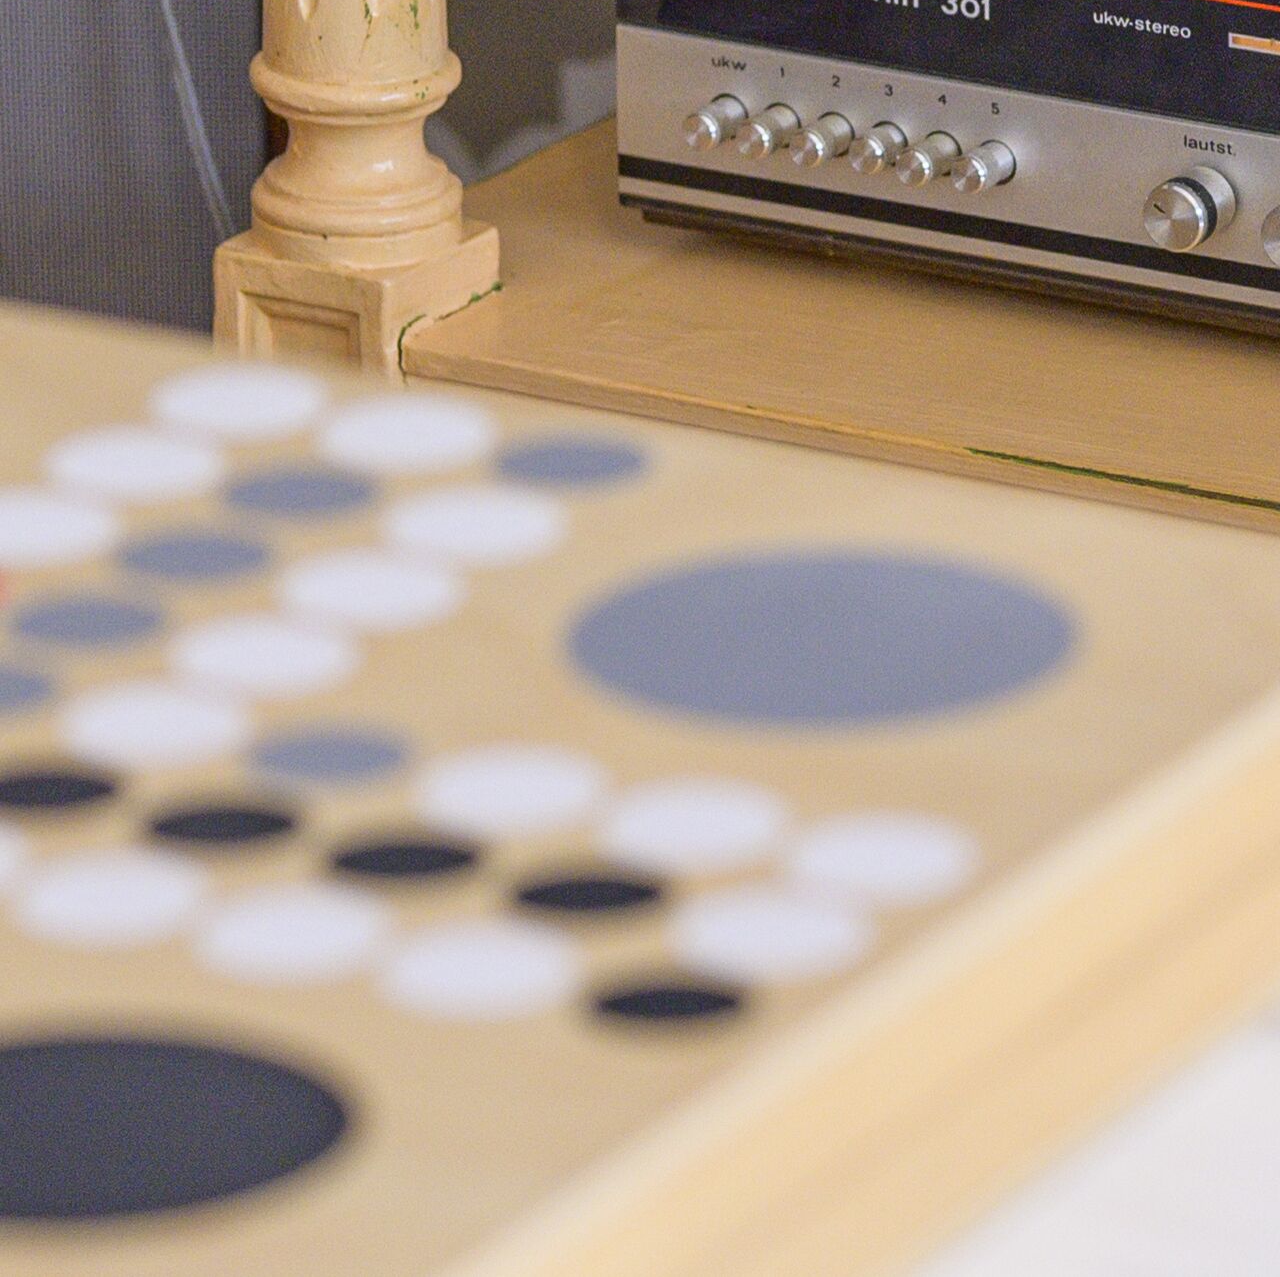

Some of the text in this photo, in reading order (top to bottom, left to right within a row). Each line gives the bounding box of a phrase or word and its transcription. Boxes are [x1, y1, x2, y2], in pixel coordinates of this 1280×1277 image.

[1093, 10, 1192, 39] ukw-stereo
[711, 56, 747, 71] ukw
[780, 67, 999, 115] 1 2 3 4 5
